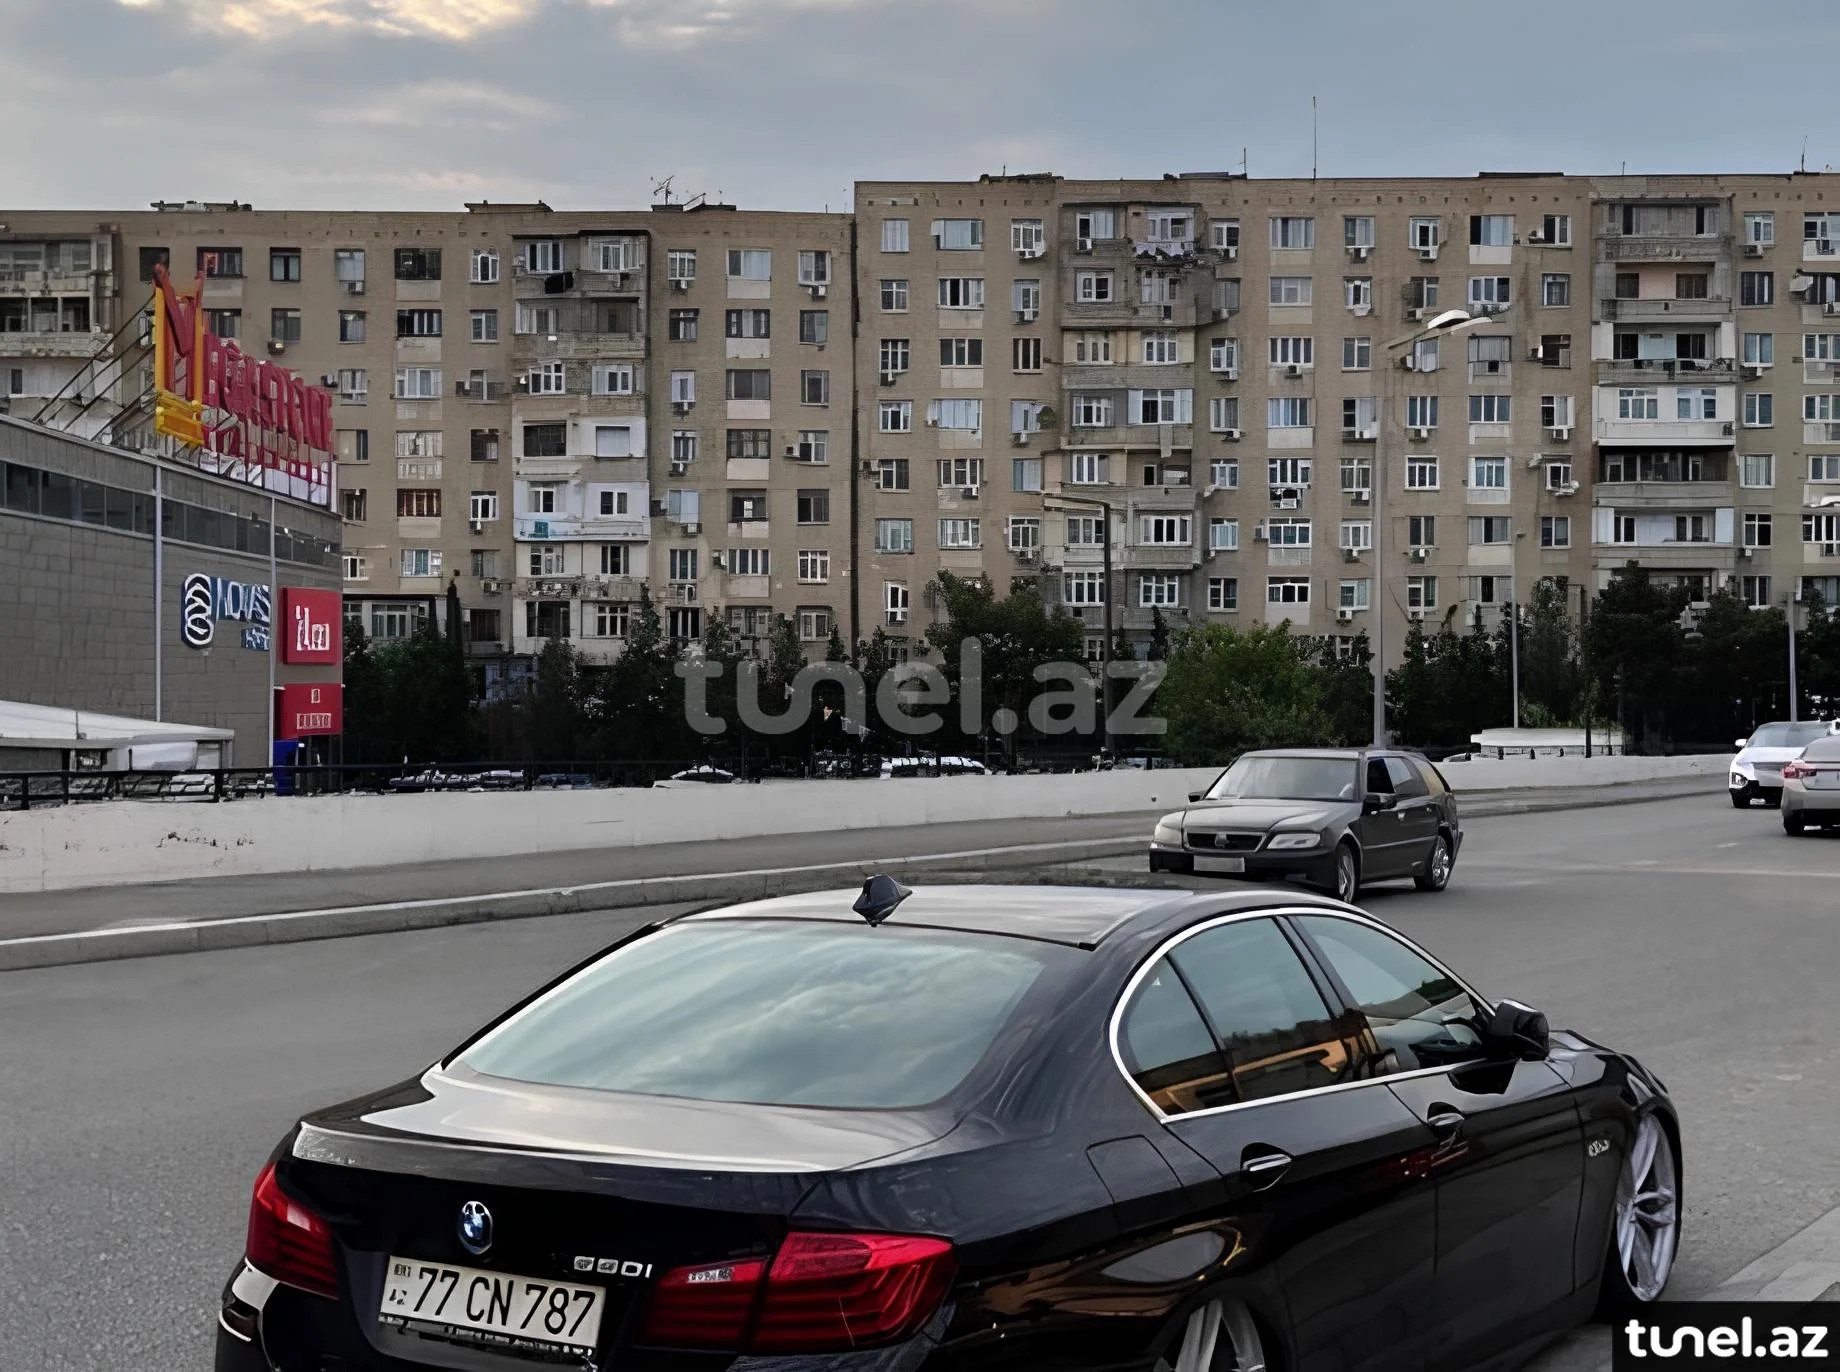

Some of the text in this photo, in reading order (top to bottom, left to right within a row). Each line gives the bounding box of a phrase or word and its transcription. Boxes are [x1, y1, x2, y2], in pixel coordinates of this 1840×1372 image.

[413, 1267, 596, 1337] 77 CN 787
